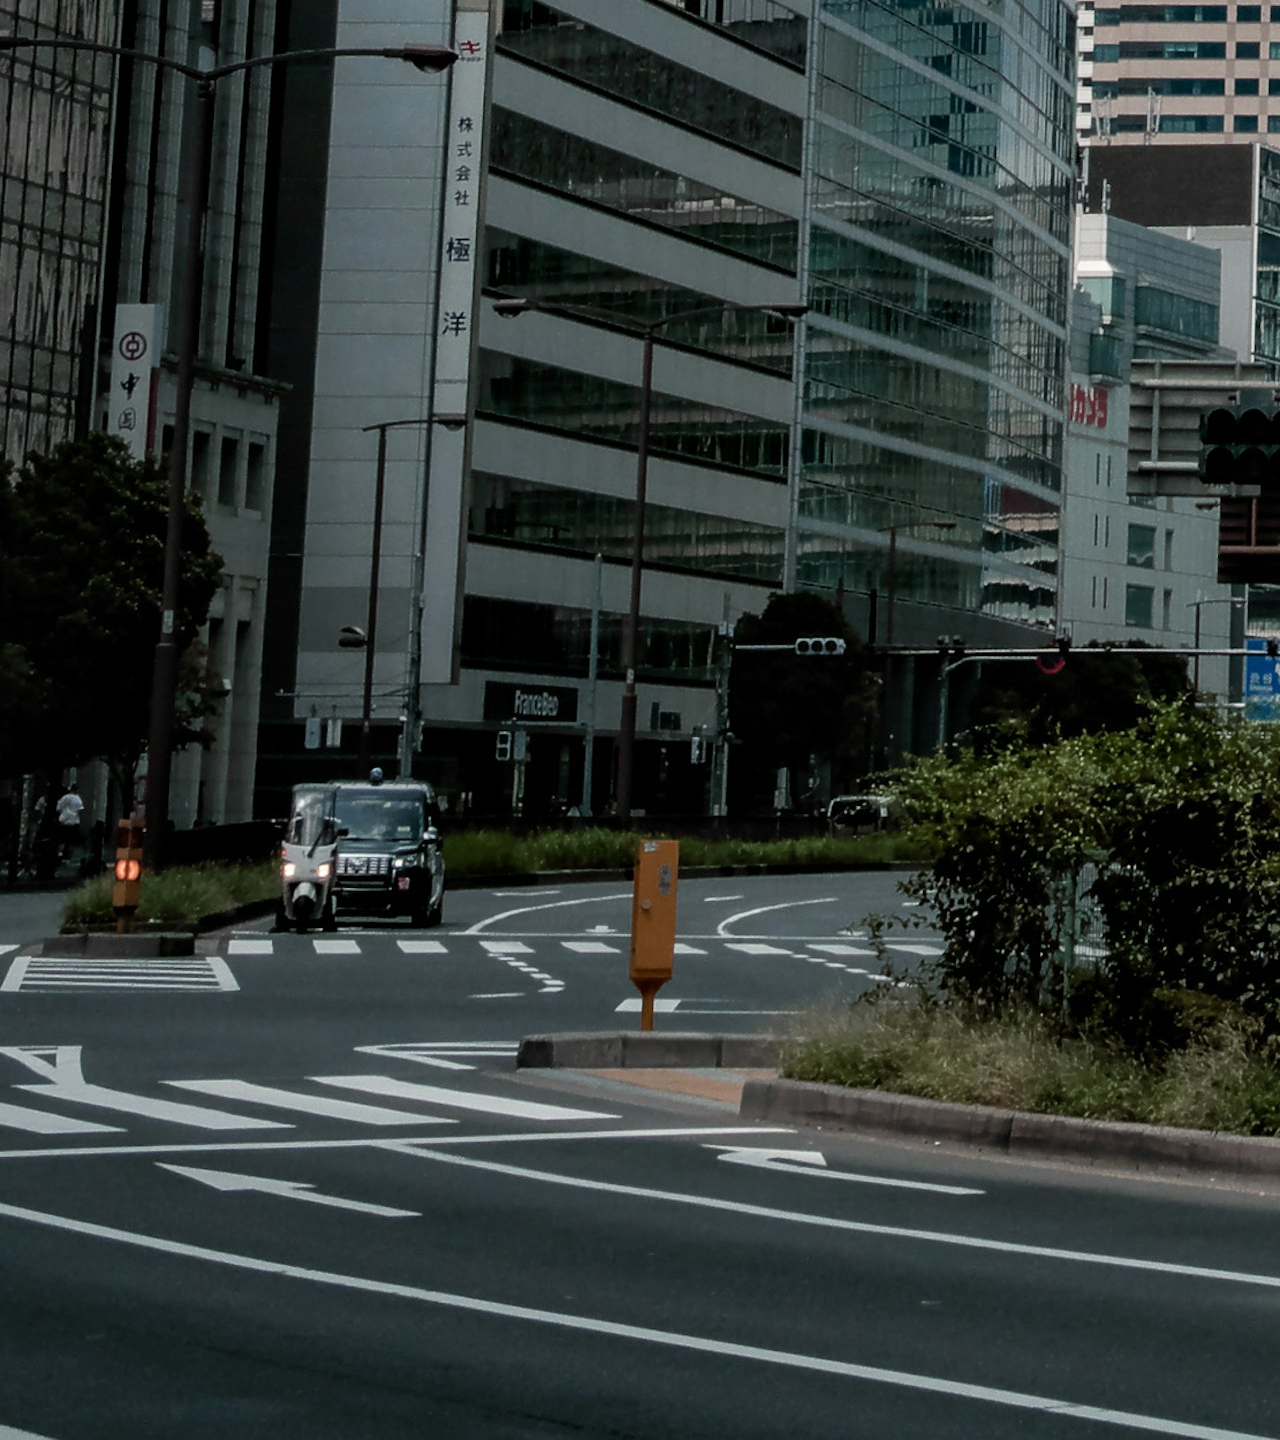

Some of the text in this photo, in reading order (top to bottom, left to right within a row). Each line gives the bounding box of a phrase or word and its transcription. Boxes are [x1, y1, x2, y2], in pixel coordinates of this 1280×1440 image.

[454, 116, 474, 207] 株式会社
[441, 236, 471, 338] 極洋
